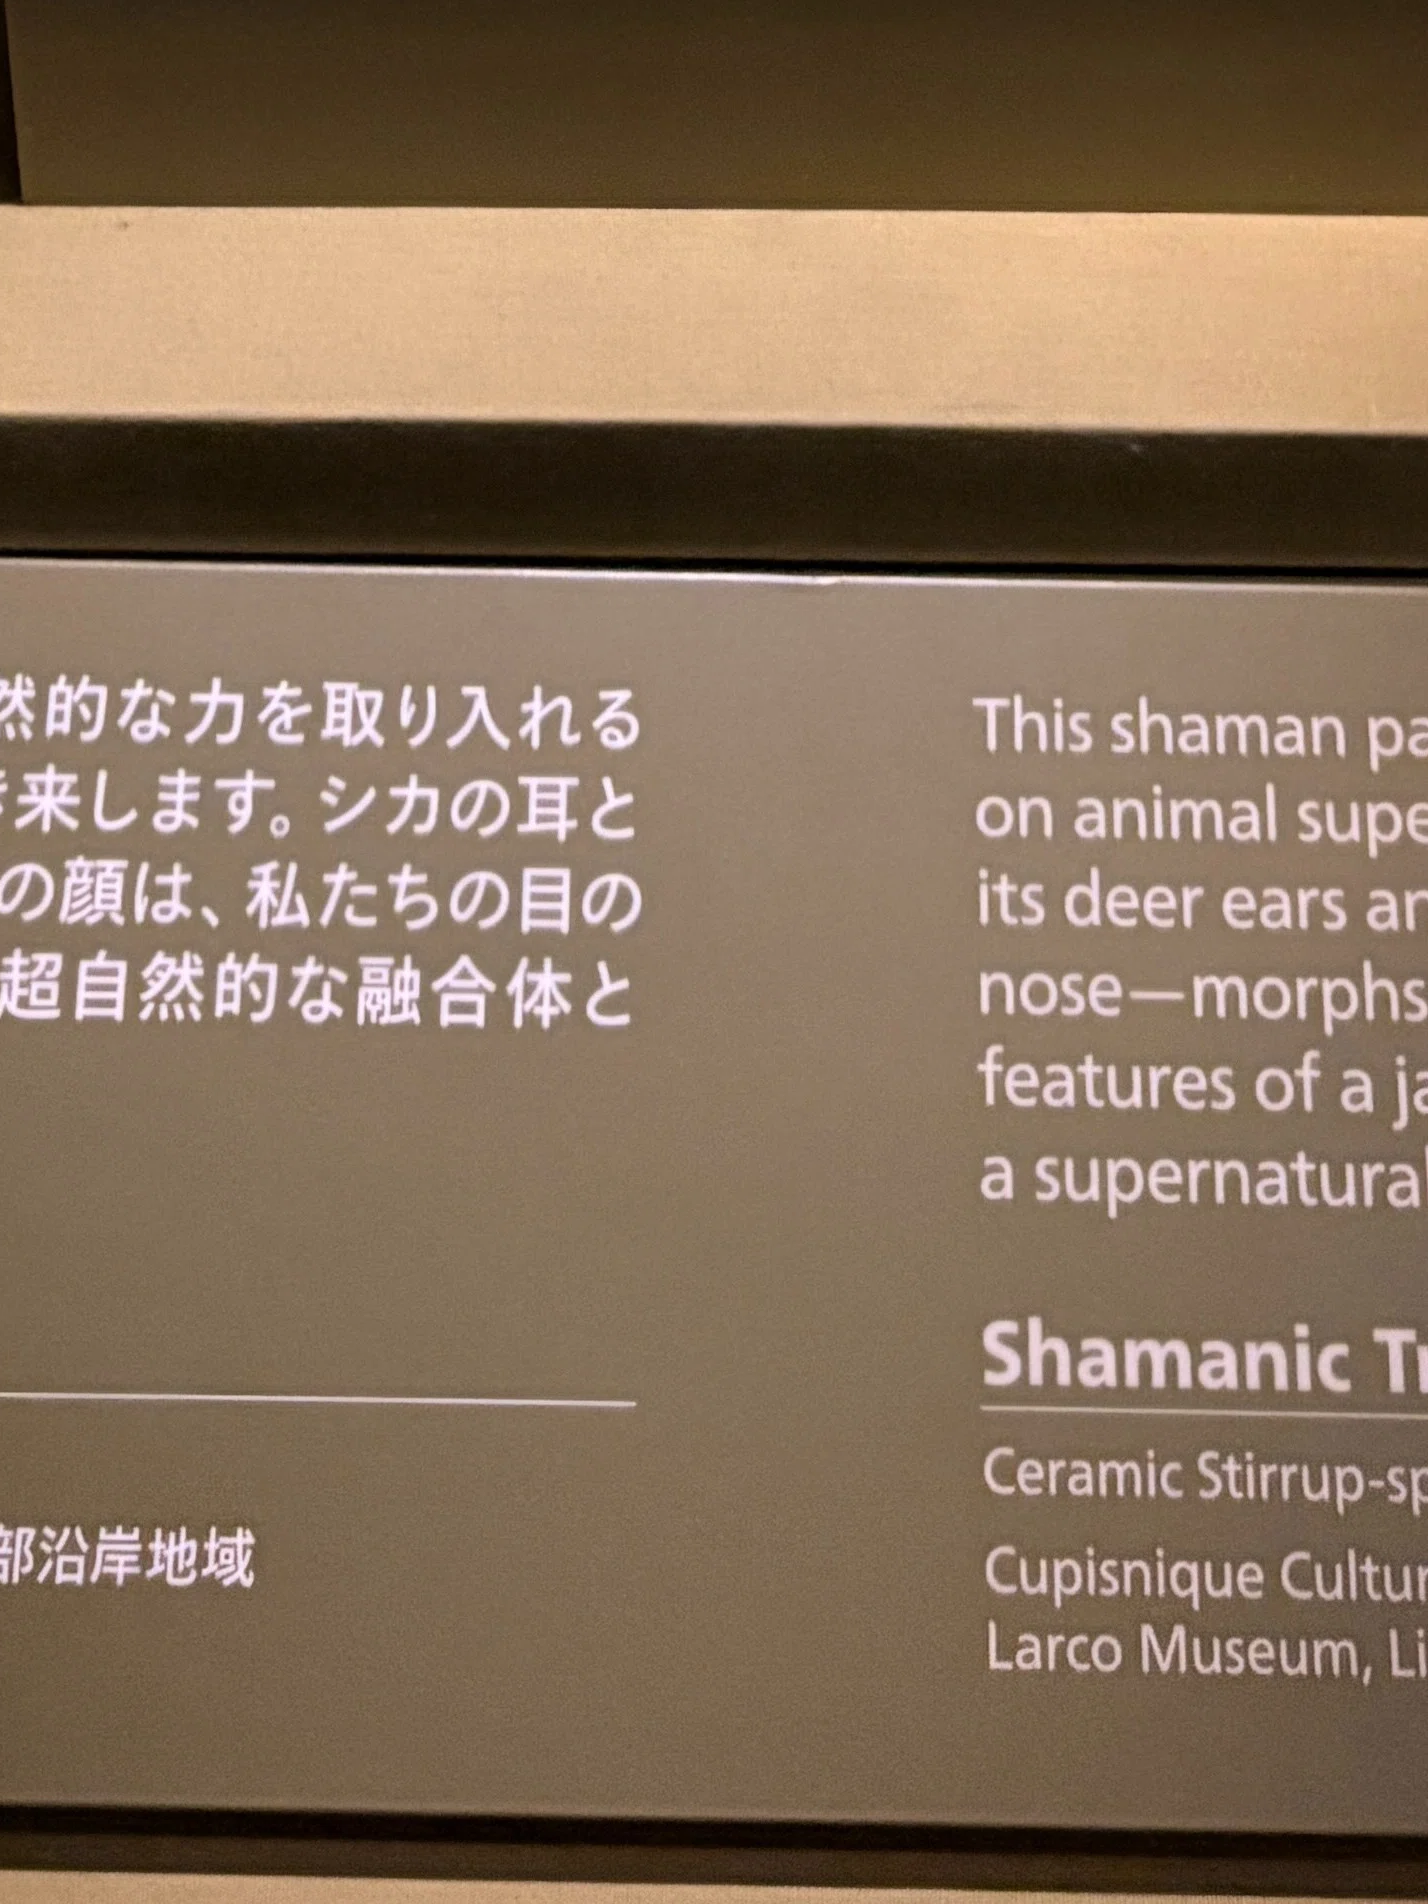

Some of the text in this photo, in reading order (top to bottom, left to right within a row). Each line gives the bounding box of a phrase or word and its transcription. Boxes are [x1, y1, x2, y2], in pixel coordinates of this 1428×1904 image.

[971, 693, 1094, 754] This
[1110, 695, 1347, 757] shaman
[975, 795, 1054, 839] on
[1073, 782, 1278, 842] animal
[978, 867, 1046, 927] its
[1064, 866, 1205, 930] deer
[1221, 886, 1348, 932] ears
[976, 1043, 1237, 1112] features
[1254, 1049, 1321, 1113] of
[1340, 1068, 1375, 1114] a
[979, 1155, 1015, 1201] a
[982, 1315, 1352, 1393] Shamanic
[982, 1445, 1184, 1500] Ceramic
[984, 1544, 1265, 1611] Cupisnique
[987, 1620, 1123, 1674] Larco
[1140, 1623, 1373, 1686] Museum,
